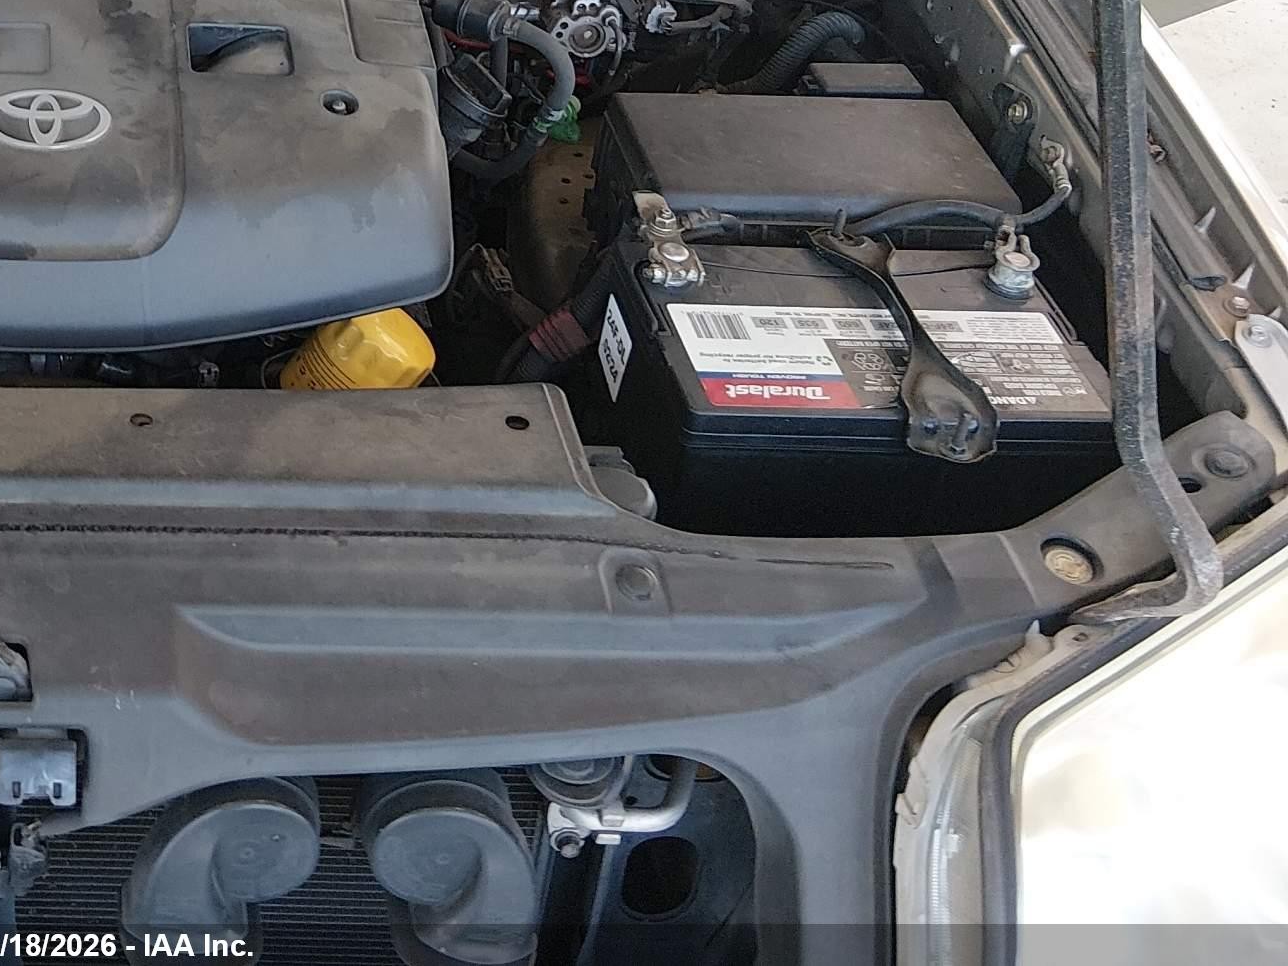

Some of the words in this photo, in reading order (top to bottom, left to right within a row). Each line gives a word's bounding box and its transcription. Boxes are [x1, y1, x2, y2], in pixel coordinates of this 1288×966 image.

[760, 318, 779, 326] 120
[724, 384, 831, 400] Duralast
[989, 396, 1028, 405] DANG
